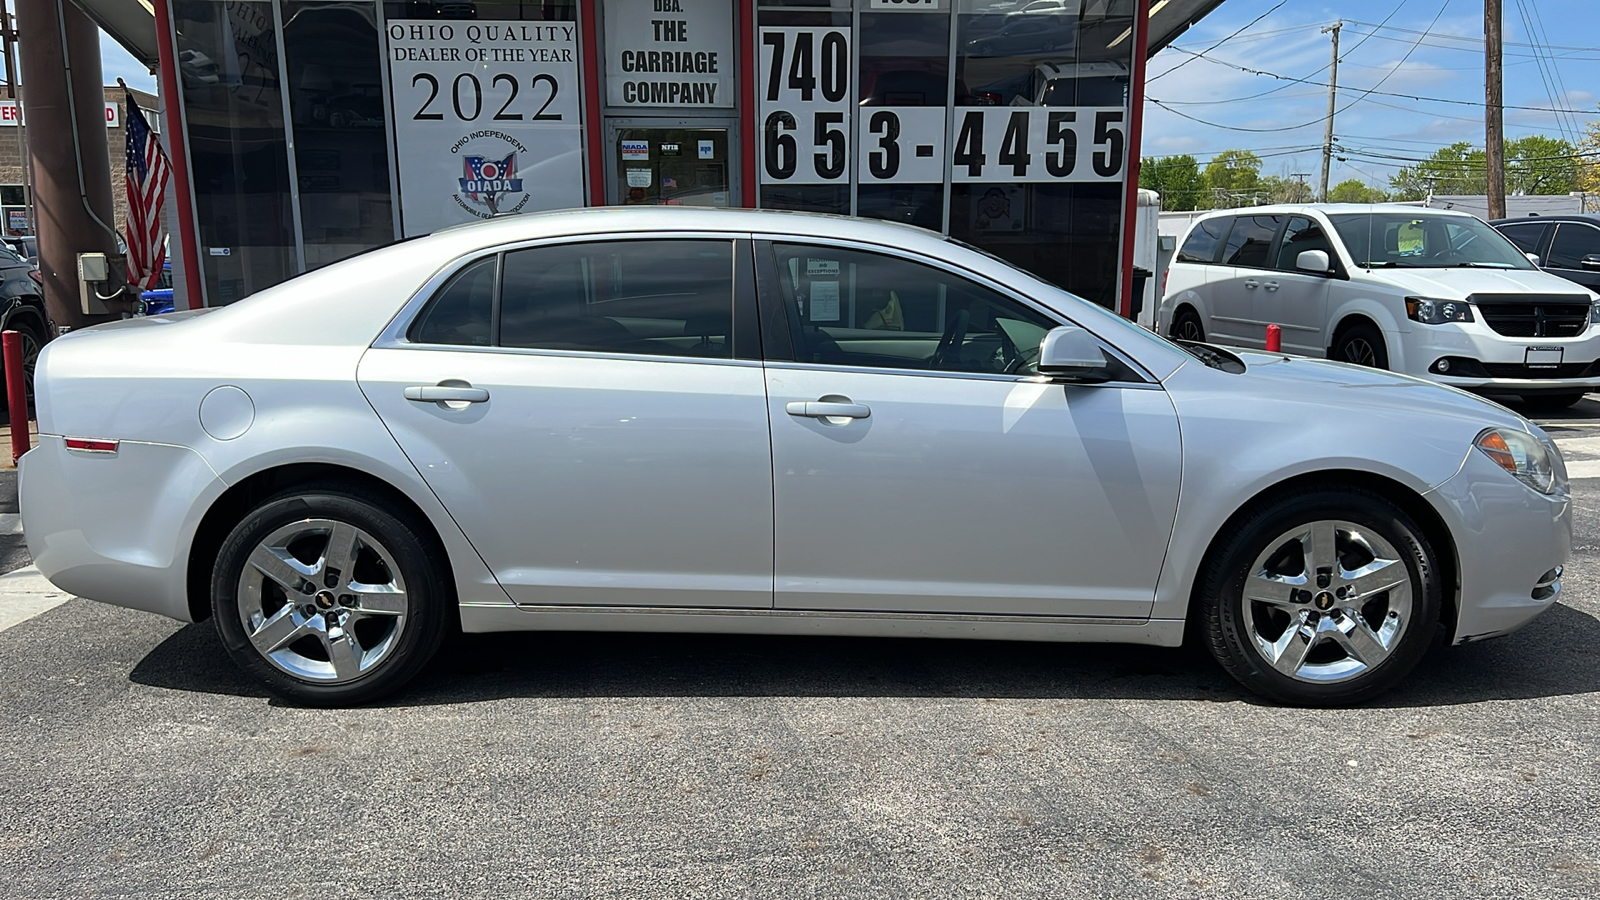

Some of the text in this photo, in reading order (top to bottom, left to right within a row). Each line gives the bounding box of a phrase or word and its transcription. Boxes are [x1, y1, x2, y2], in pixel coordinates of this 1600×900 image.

[390, 24, 574, 44] OHIO QUALITY
[650, 19, 688, 42] THE
[393, 47, 573, 63] DEALER OF THE YEAR
[621, 50, 719, 74] CARRIAGE
[762, 31, 848, 102] 740
[412, 72, 563, 122] 2022
[622, 81, 718, 105] COMPANY
[451, 130, 527, 154] OHIO INDEPENDENT
[467, 180, 512, 192] OIADA
[453, 194, 481, 217] AUTOMOBILE
[1404, 535, 1430, 579] ALTIMAX
